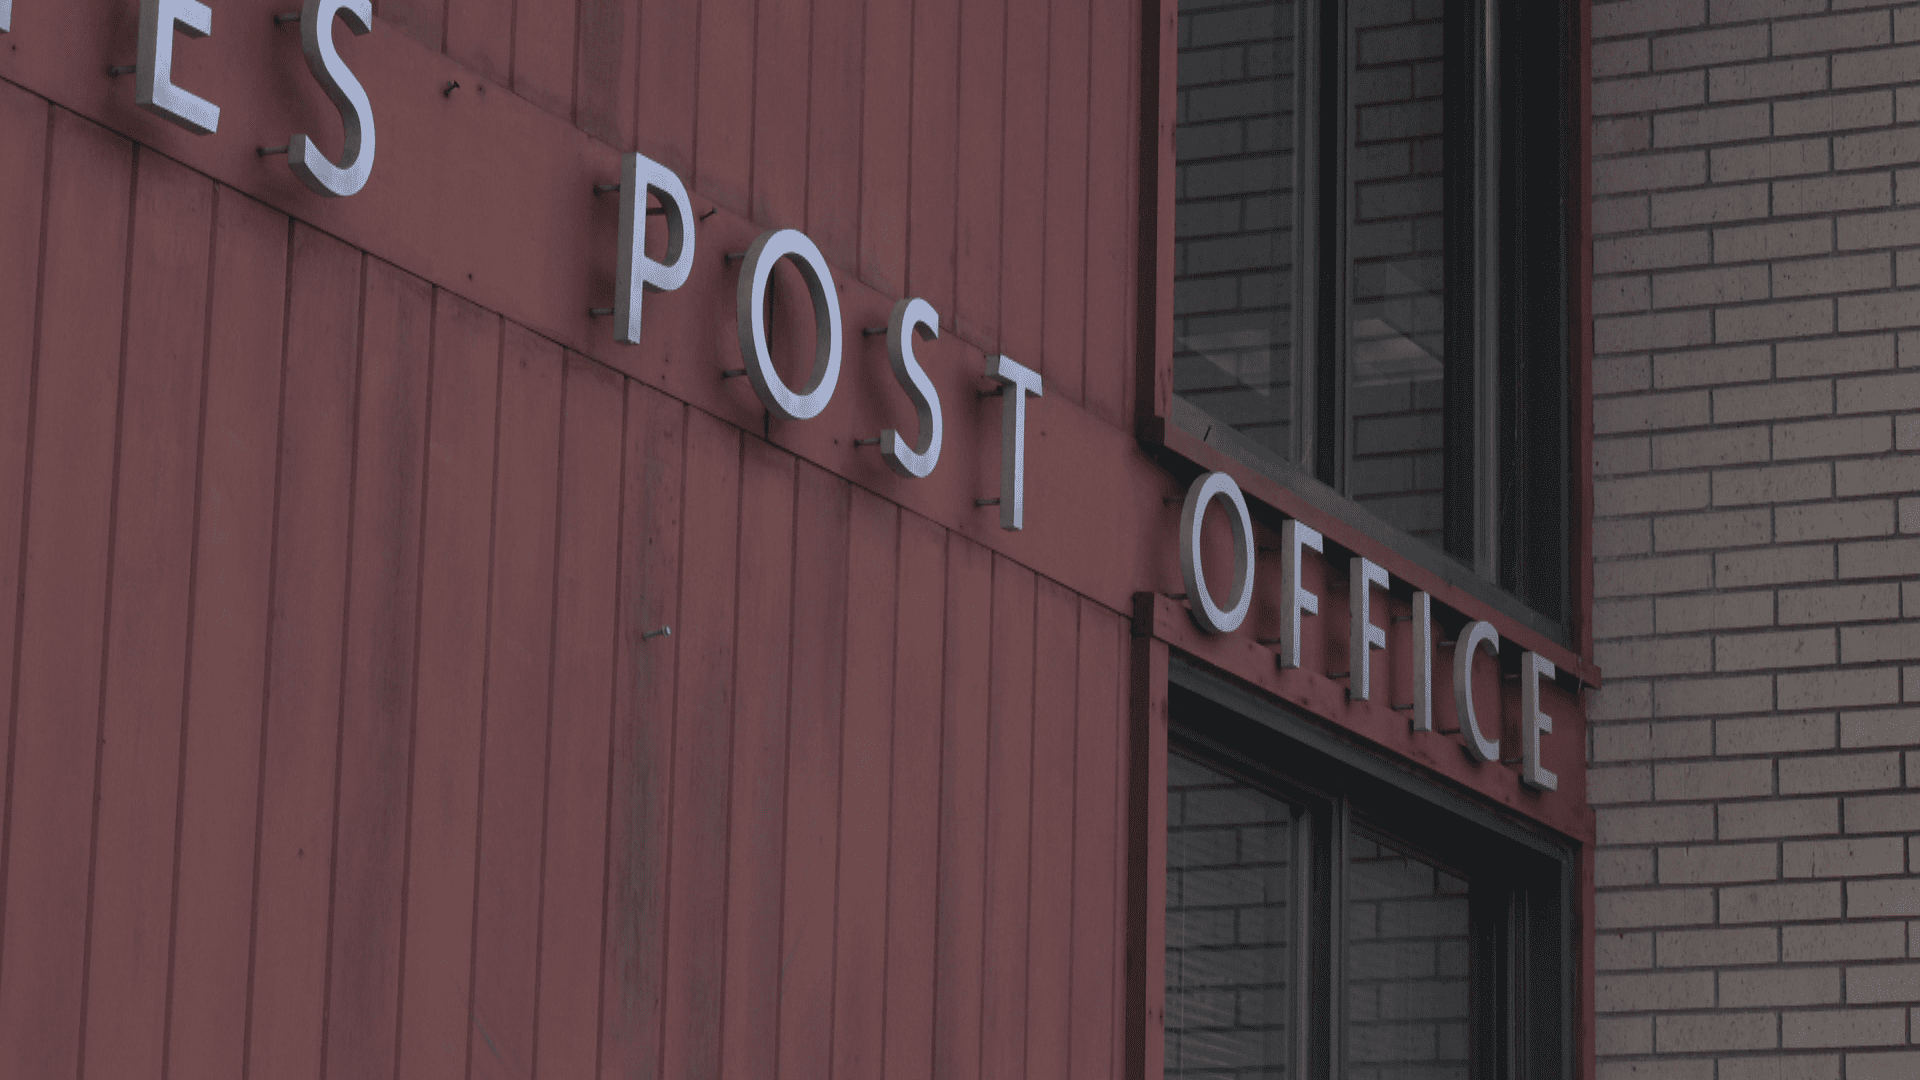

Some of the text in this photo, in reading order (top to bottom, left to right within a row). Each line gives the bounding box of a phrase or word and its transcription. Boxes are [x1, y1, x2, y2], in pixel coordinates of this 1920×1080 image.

[0, 0, 1558, 791] ES POST OFFICE
